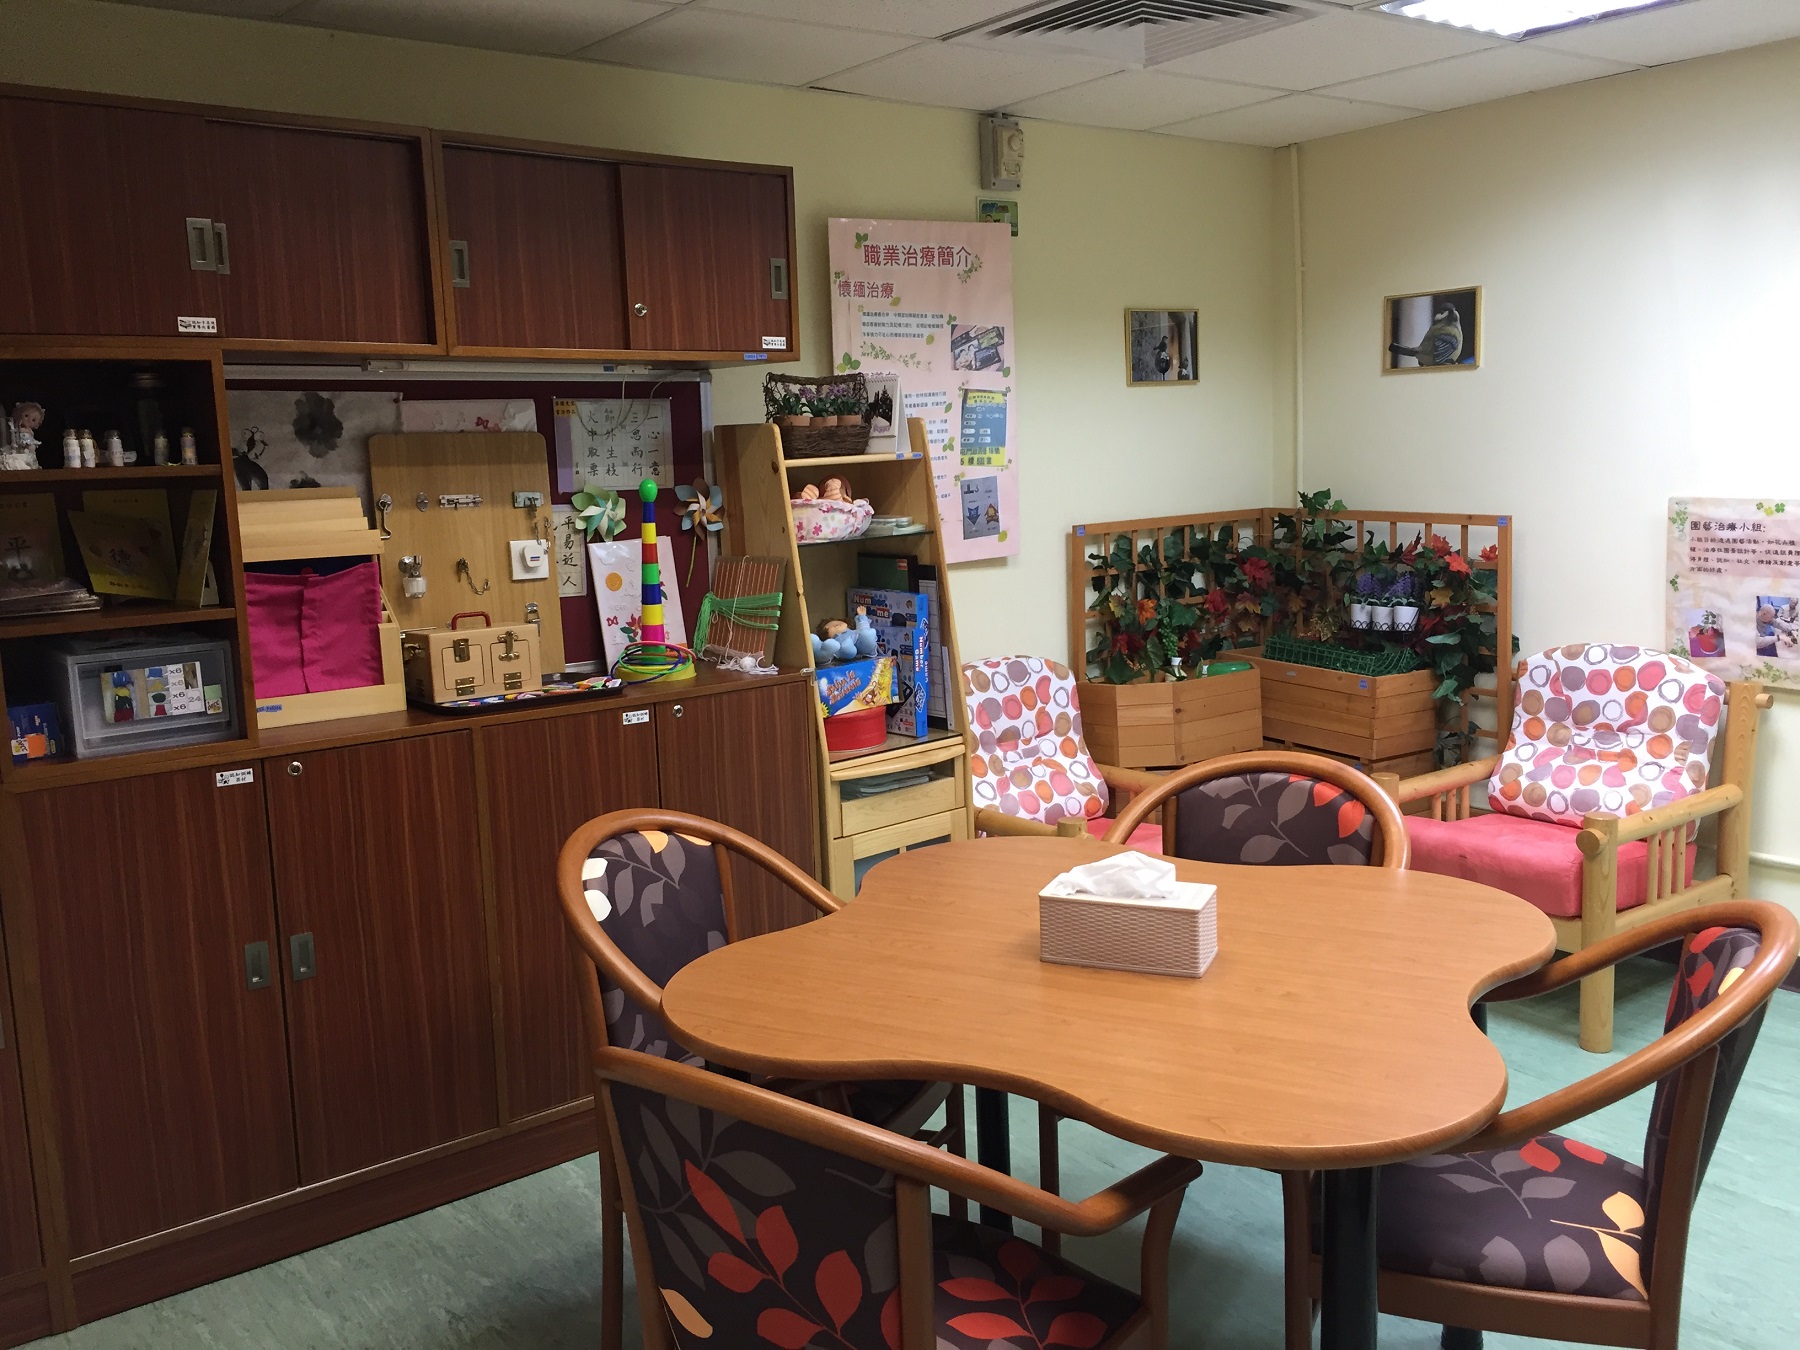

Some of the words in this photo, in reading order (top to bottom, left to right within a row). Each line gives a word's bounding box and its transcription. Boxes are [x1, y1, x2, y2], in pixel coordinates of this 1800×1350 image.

[863, 245, 972, 268] 職業治療簡介
[837, 280, 895, 299] 懷緬治療
[604, 408, 619, 477] 節外生枝
[630, 412, 644, 476] 三思而行
[647, 414, 660, 476] 一心一意
[560, 516, 578, 587] 平易近人
[168, 667, 182, 676] x6
[171, 679, 184, 687] x6
[172, 691, 186, 699] x6
[188, 695, 201, 703] 24
[173, 703, 187, 711] x6
